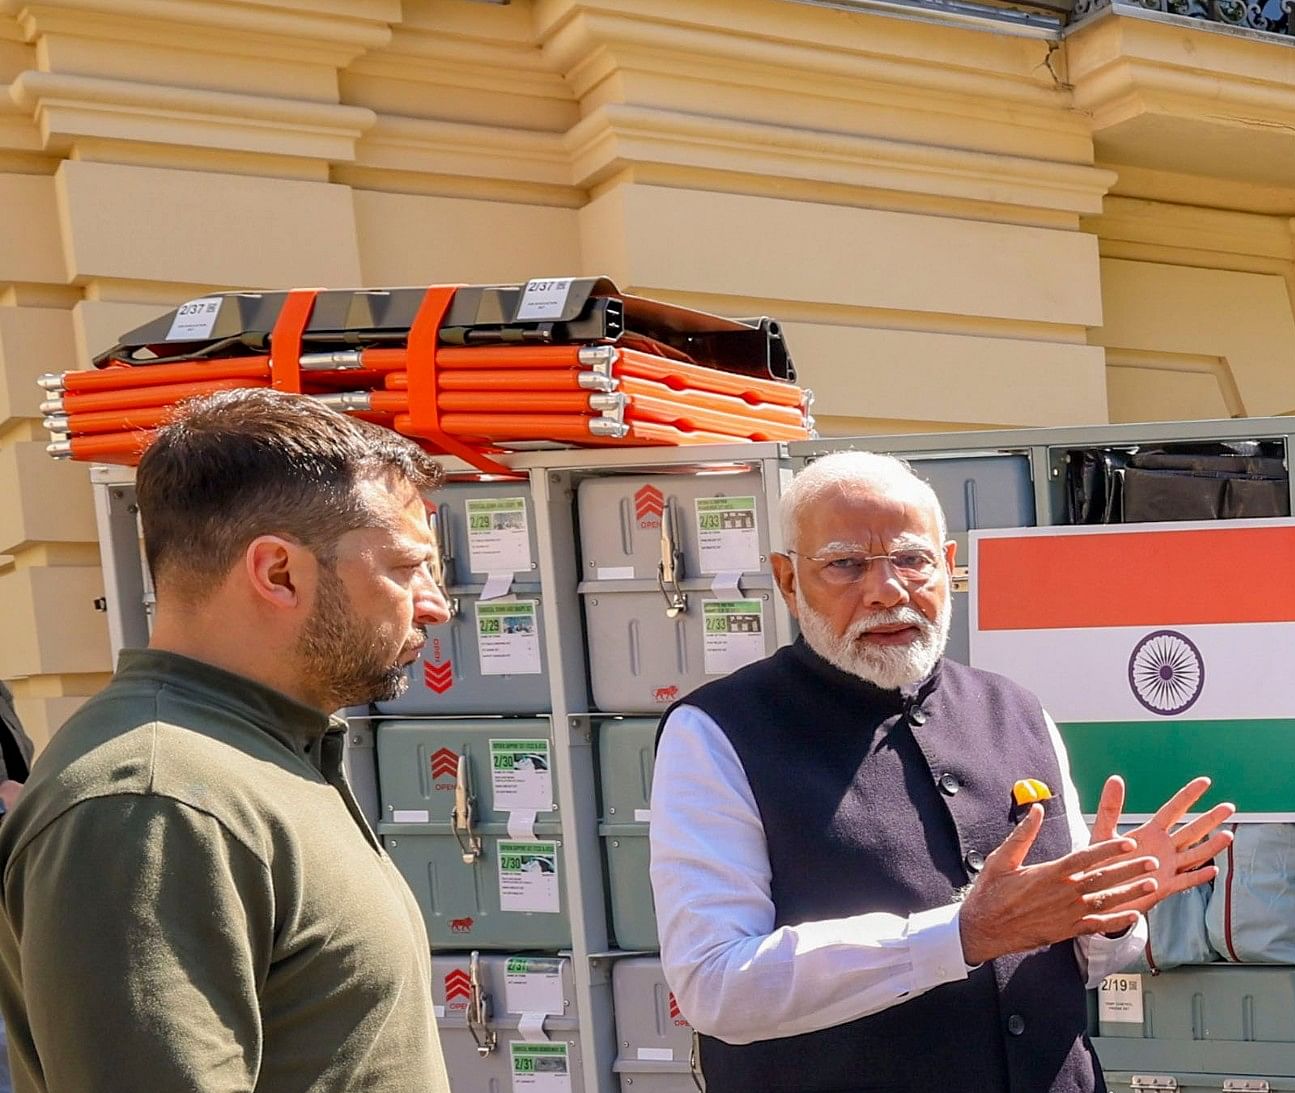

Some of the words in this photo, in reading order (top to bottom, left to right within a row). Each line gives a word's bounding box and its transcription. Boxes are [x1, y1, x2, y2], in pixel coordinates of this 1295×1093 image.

[528, 282, 553, 291] 2/37
[180, 304, 204, 315] 2/37
[470, 516, 490, 528] 2/29
[700, 515, 719, 527] 2/33
[480, 619, 500, 632] 2/29
[705, 618, 727, 630] 2/33
[493, 756, 514, 767] 2/30
[501, 857, 521, 869] 2/30
[1102, 979, 1127, 991] 2/19
[514, 1057, 533, 1070] 2/31
